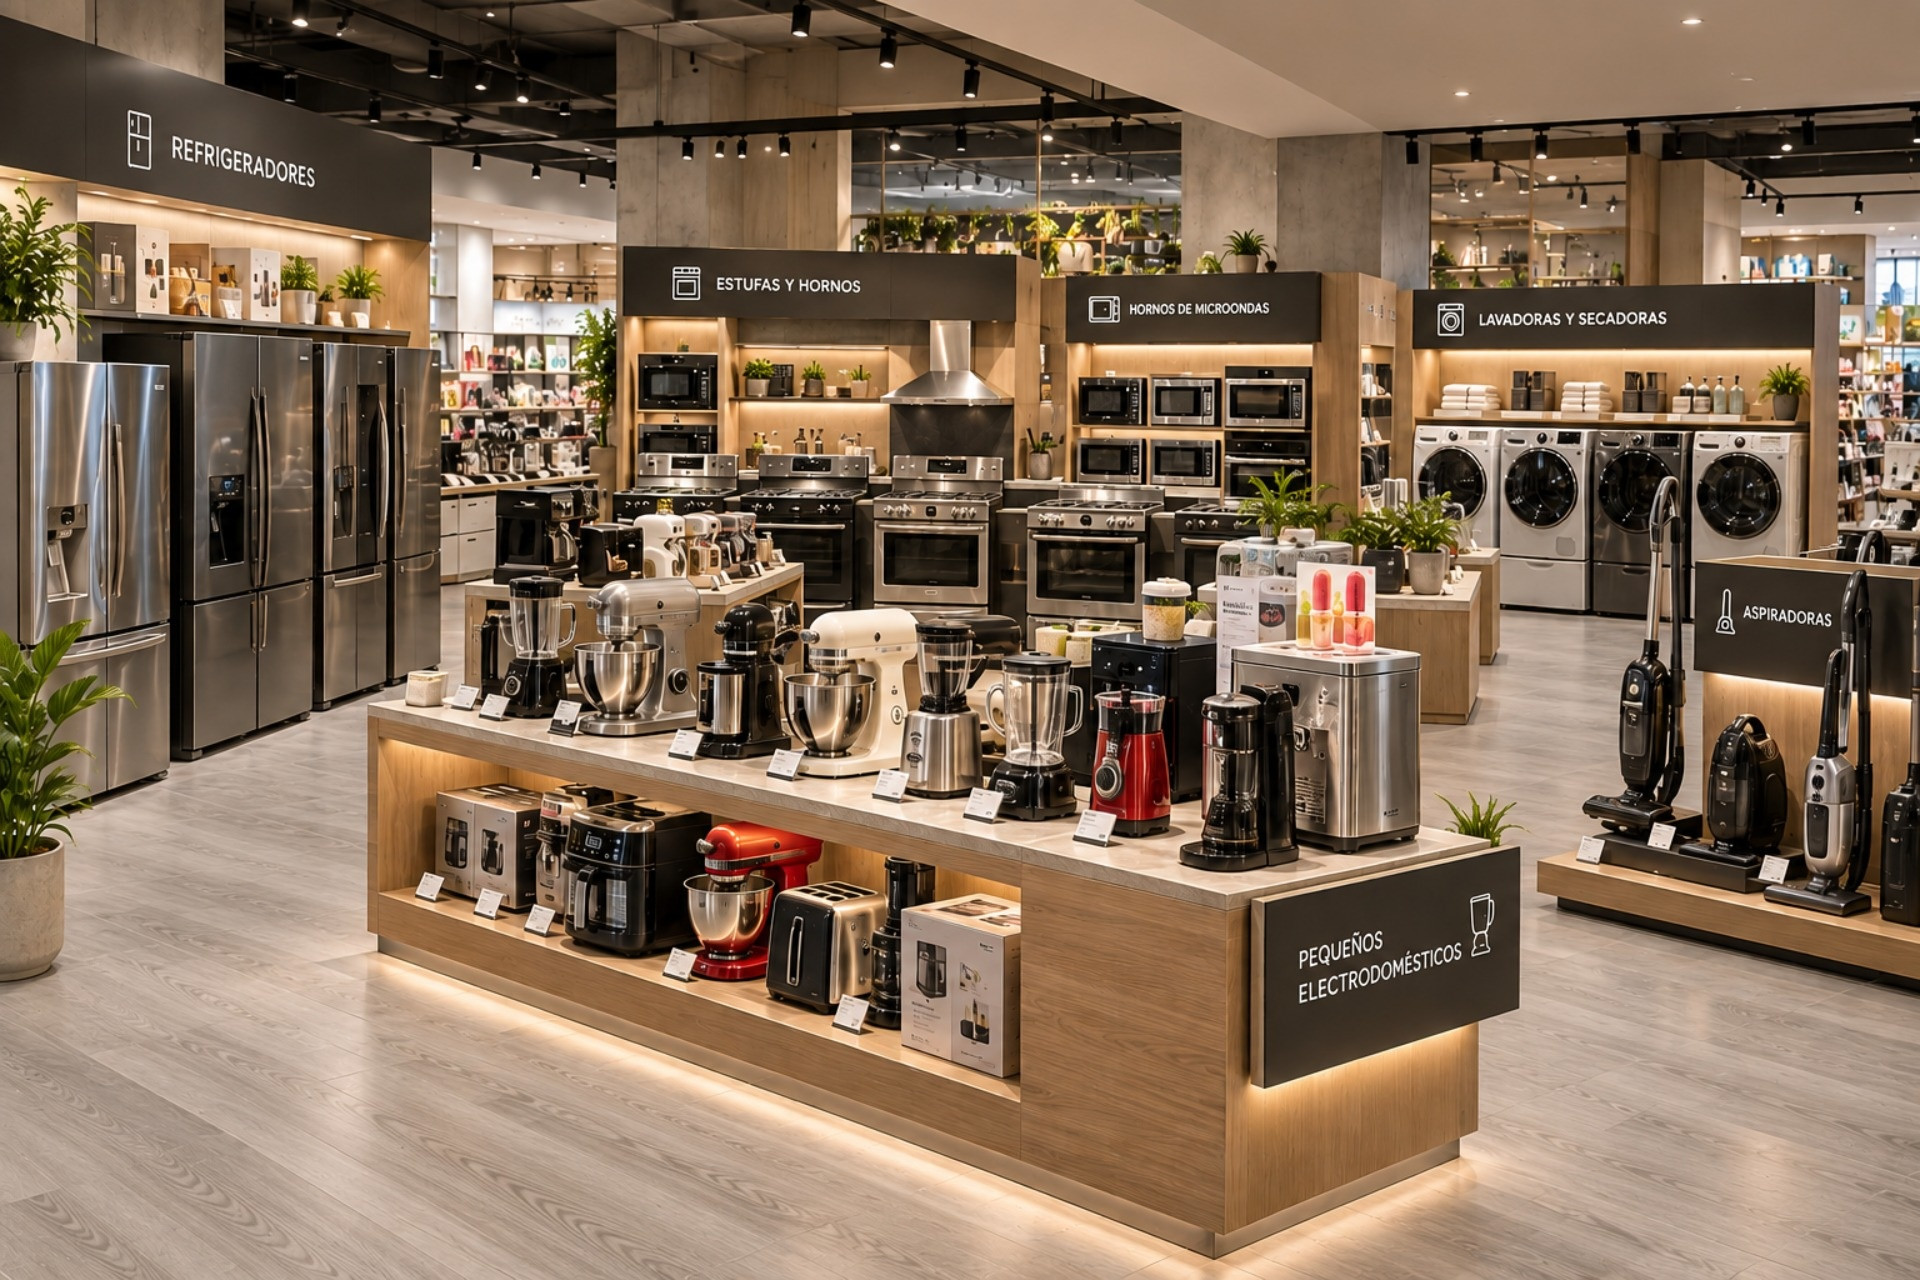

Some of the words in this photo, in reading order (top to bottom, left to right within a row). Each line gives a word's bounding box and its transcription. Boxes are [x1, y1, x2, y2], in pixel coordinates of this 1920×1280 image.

[171, 135, 316, 189] REFRIGERADORES
[716, 277, 781, 292] ESTUFAS
[784, 278, 795, 292] Y
[799, 278, 861, 294] HORNOS
[1129, 303, 1176, 316] HORNOS
[1177, 303, 1192, 315] DE
[1194, 302, 1270, 315] MICROONDAS
[1479, 312, 1562, 327] LAVADORAS
[1565, 312, 1575, 326] Y
[1578, 311, 1668, 326] SECADORAS
[1743, 605, 1833, 628] ASPIRADORAS
[1299, 930, 1384, 970] PEQUEÑOS
[1298, 942, 1463, 1004] ELECTRODOMÉSTICOS
